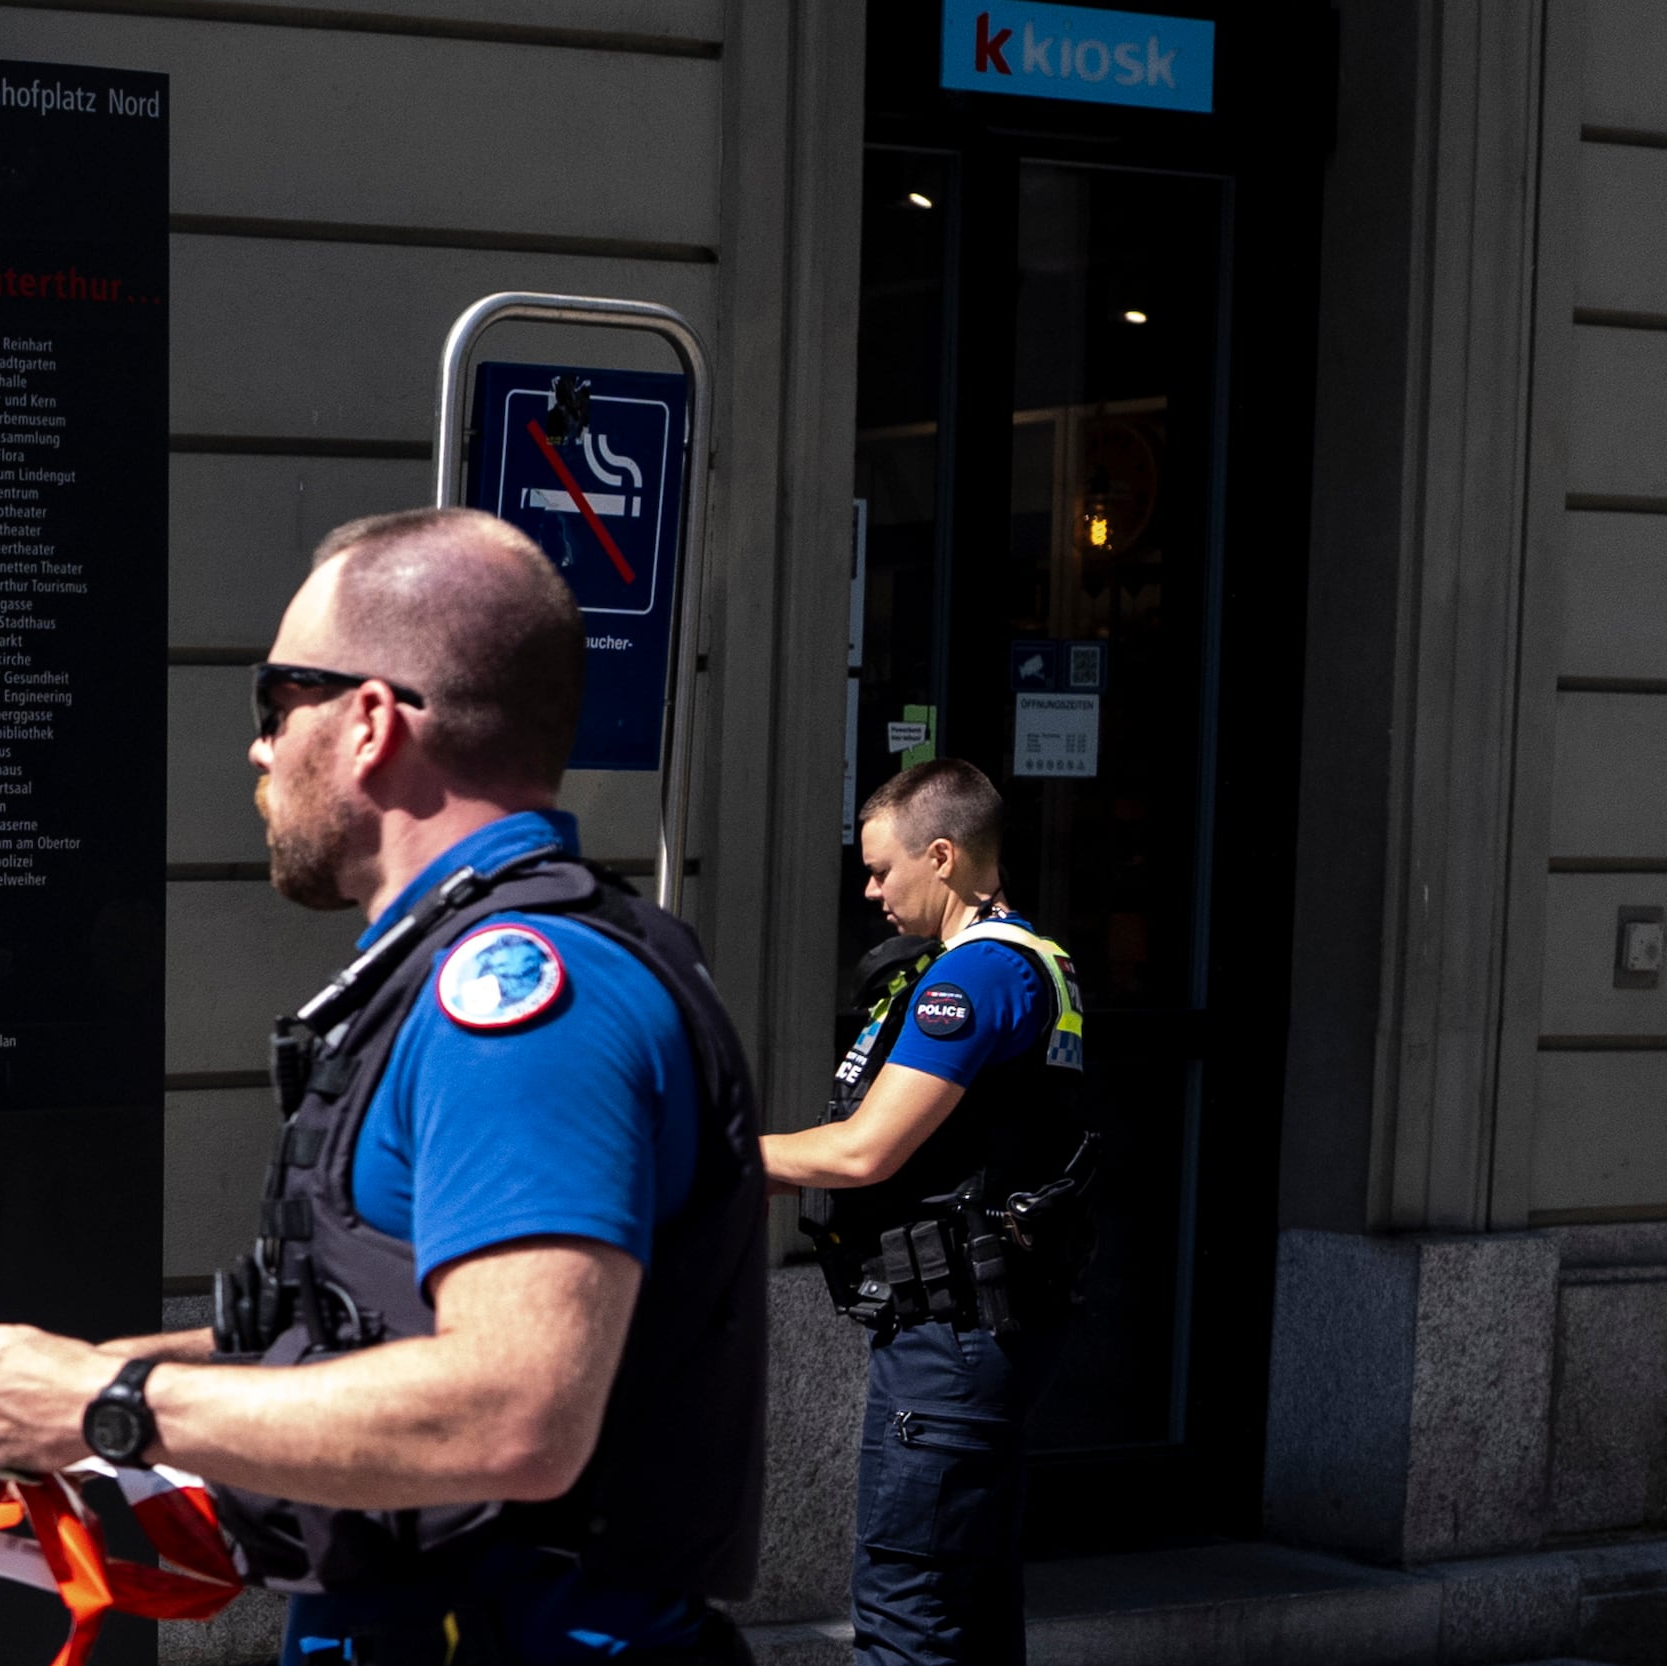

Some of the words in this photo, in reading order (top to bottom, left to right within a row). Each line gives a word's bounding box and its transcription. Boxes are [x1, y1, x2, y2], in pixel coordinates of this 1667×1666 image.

[975, 11, 1013, 75] k
[1022, 20, 1180, 89] kiosk
[108, 87, 160, 118] Nord
[3, 337, 51, 351] Reinhart
[4, 393, 26, 406] und
[30, 394, 56, 406] Kern
[18, 468, 75, 485] Lindengut
[40, 561, 82, 574] Theater
[31, 580, 87, 593] Tourismus
[584, 634, 633, 651] aucher-
[3, 671, 68, 684] Gesundheit
[4, 689, 72, 705] Engineering
[15, 840, 33, 849] am
[37, 837, 80, 849] Obertor
[917, 1004, 967, 1018] POLICE
